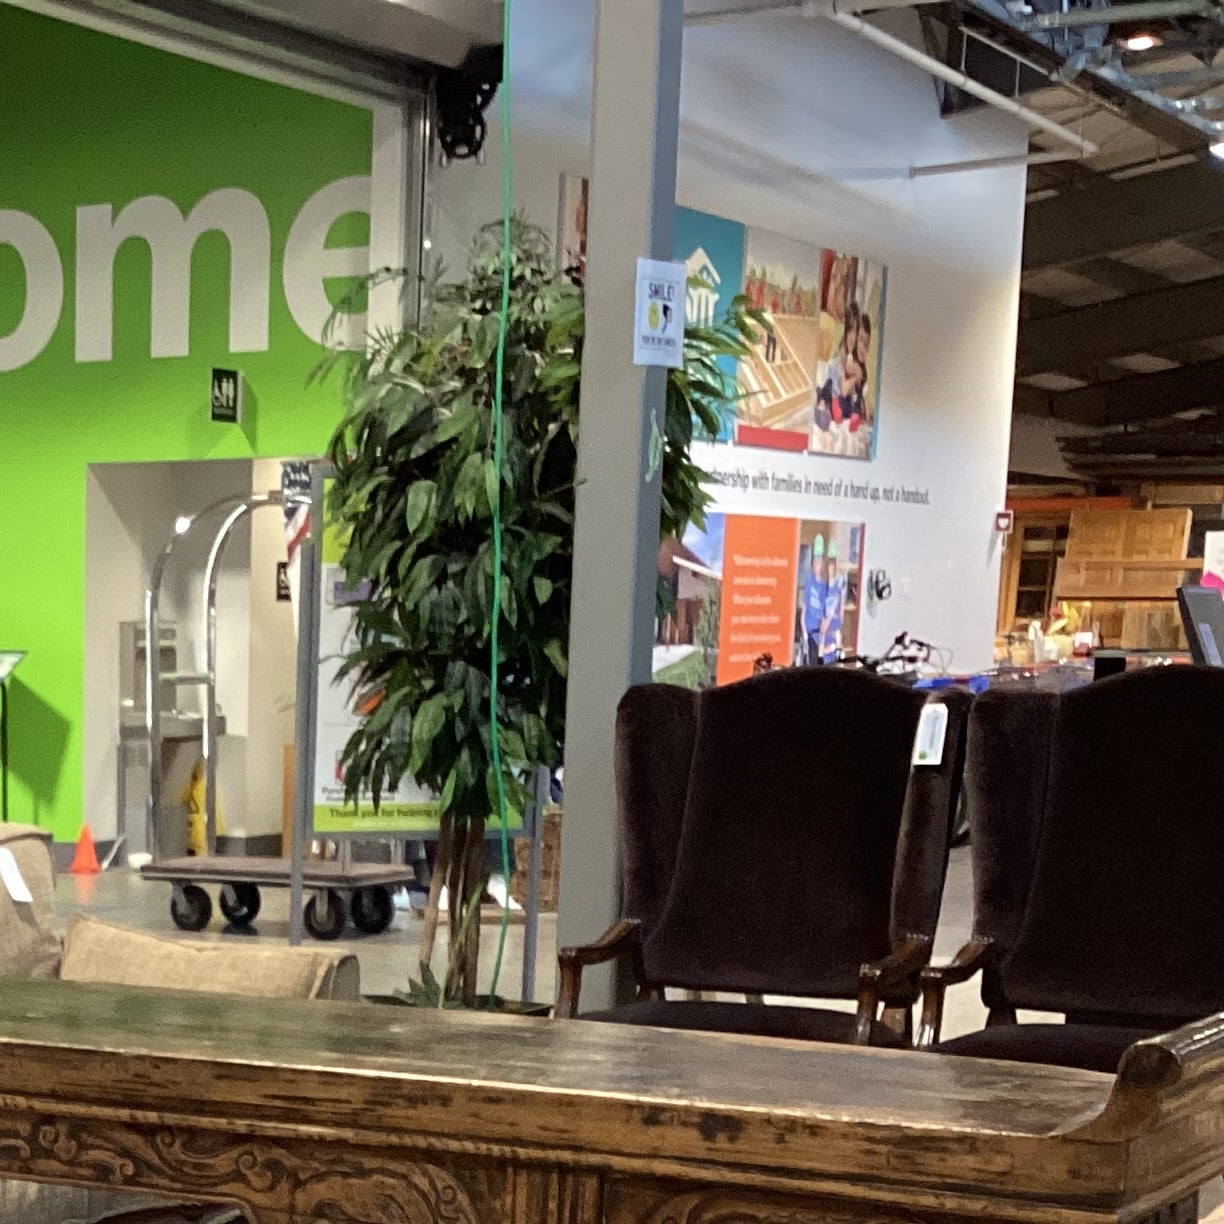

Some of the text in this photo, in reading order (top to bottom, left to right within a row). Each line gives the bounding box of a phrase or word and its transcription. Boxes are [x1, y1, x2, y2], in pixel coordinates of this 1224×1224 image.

[752, 470, 771, 492] with
[772, 472, 803, 494] families
[804, 475, 811, 495] in
[813, 476, 833, 497] need
[834, 477, 843, 497] of
